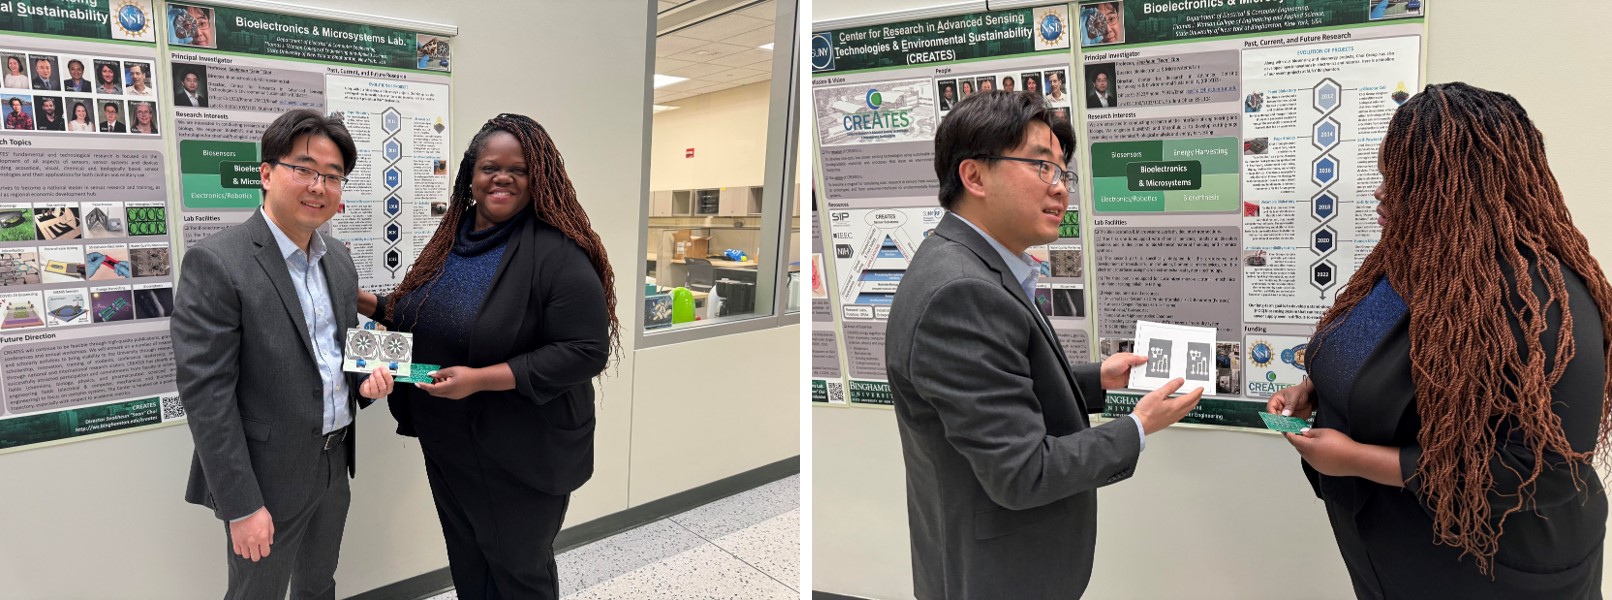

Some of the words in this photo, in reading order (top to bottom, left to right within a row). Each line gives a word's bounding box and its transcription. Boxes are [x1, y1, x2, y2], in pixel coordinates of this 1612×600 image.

[1144, 0, 1222, 14] Bioelectronics
[17, 2, 108, 24] Sustainability
[236, 16, 309, 34] Bioelectronics
[312, 26, 320, 36] &
[322, 28, 386, 44] Microsystems
[388, 36, 406, 46] Lab.
[840, 32, 866, 44] Center
[870, 29, 880, 38] for
[884, 24, 924, 38] Research
[927, 22, 934, 32] in
[938, 17, 982, 32] Advanced
[986, 14, 1024, 26] Sensing
[1042, 24, 1060, 34] NSF
[1322, 32, 1351, 41] Research
[835, 44, 890, 59] Technologies
[893, 41, 900, 50] &
[902, 32, 966, 51] Environmental
[969, 28, 1033, 44] Sustainability
[172, 53, 198, 62] Principal
[199, 56, 233, 66] Investigator
[907, 49, 956, 66] (CREATES)
[844, 110, 910, 131] CREATES
[1174, 149, 1194, 157] Energy
[1140, 165, 1188, 173] Bioelectronics
[1146, 179, 1192, 188] Microsystems
[191, 192, 253, 200] Electronics/Robotics
[832, 212, 850, 221] SIP
[837, 247, 850, 256] NIH
[25, 333, 56, 341] Direction
[133, 402, 156, 410] CREATES
